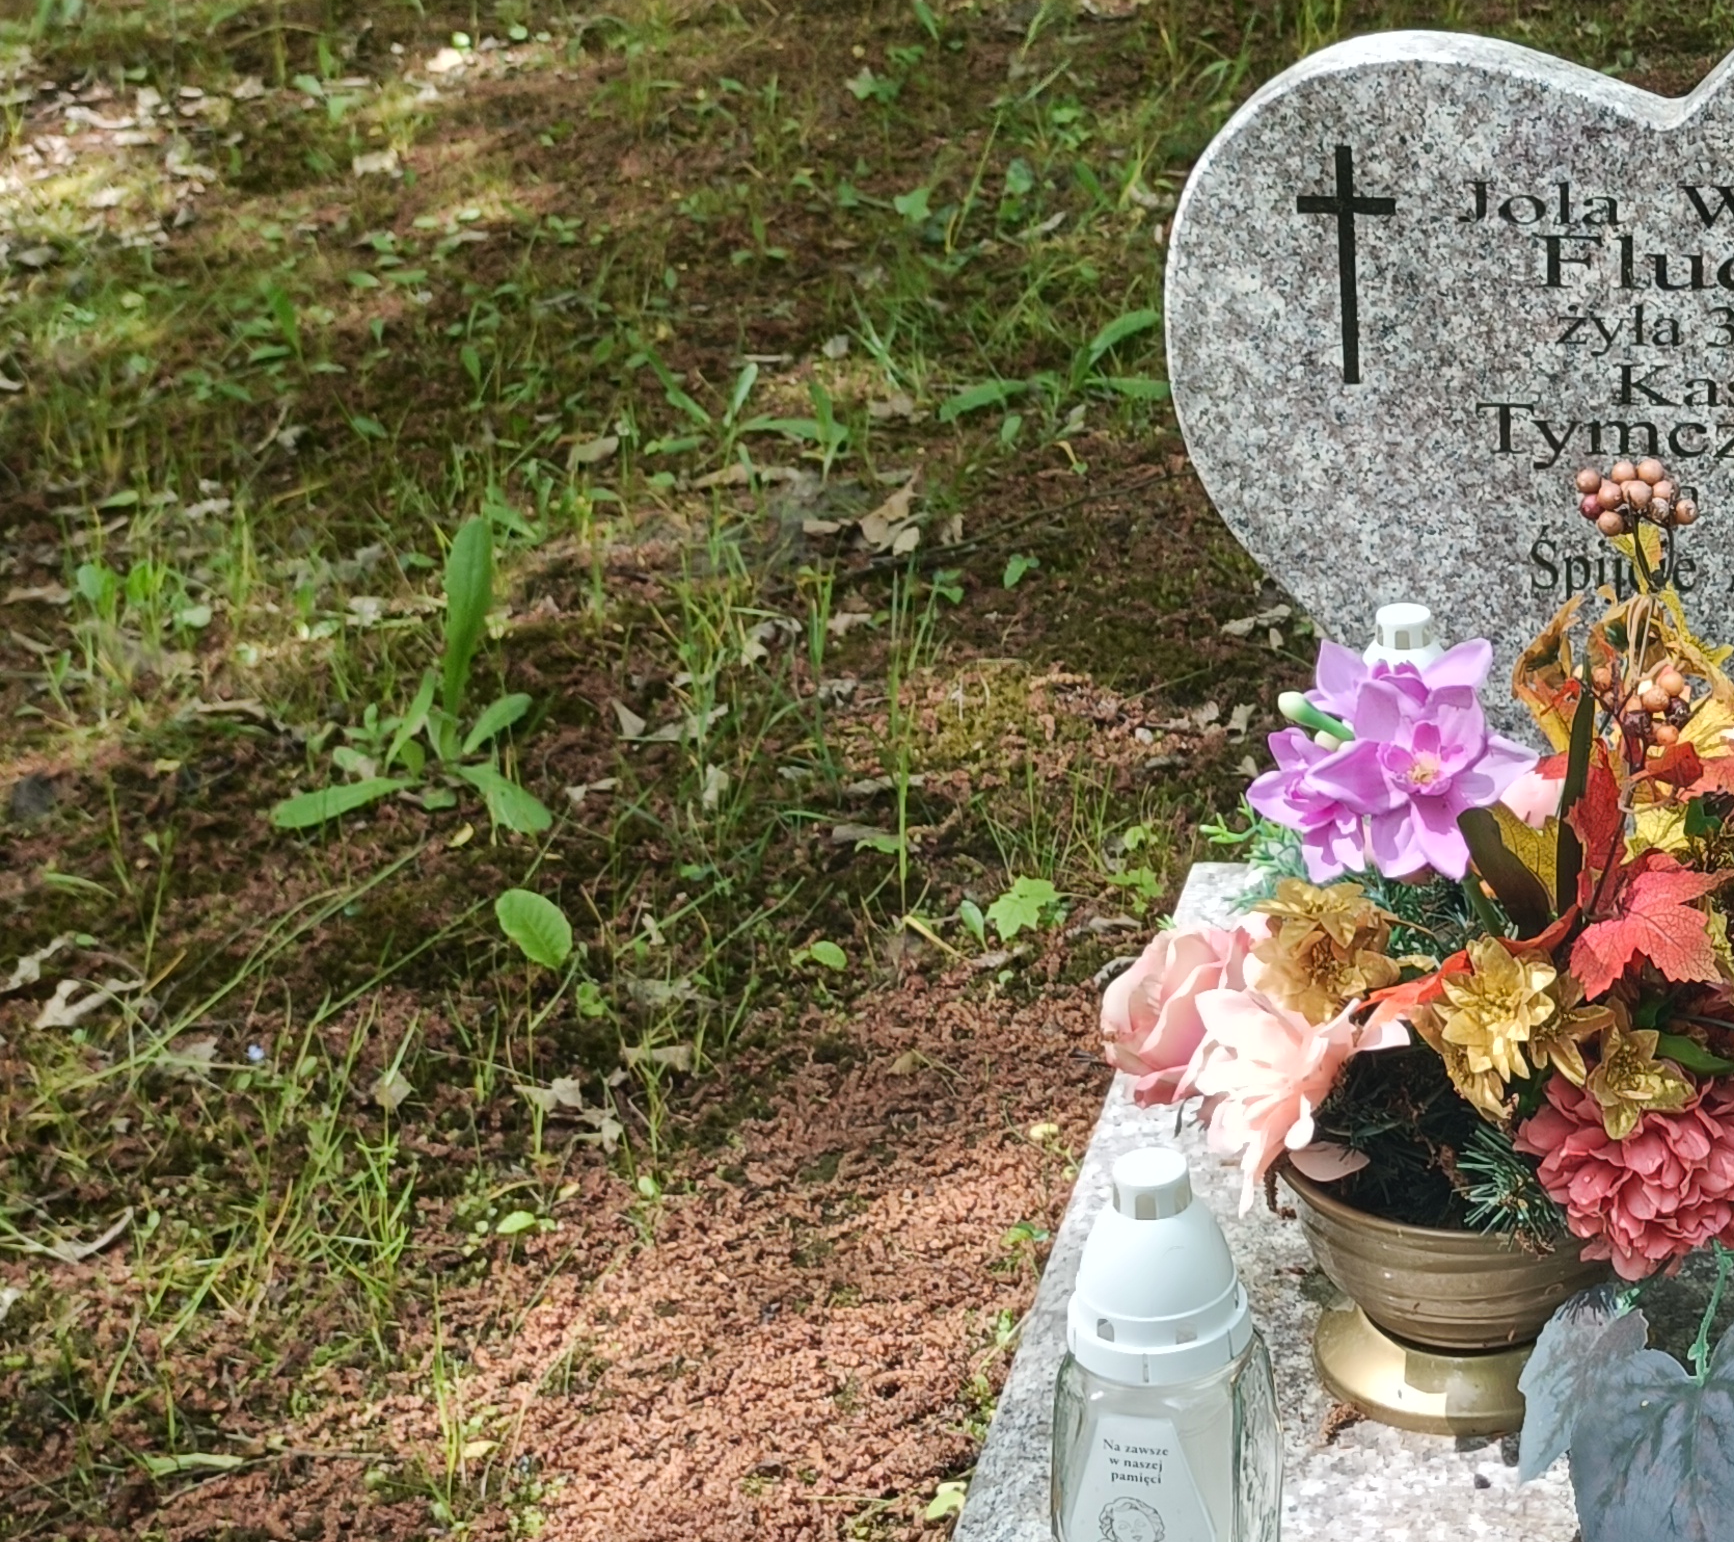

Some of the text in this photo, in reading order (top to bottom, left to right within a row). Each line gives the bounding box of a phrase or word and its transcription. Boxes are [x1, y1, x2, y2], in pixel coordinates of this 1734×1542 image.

[1458, 180, 1622, 226] Jola
[1555, 303, 1682, 357] żyła
[1103, 1439, 1169, 1457] Na zawsze
[1109, 1457, 1162, 1473] w naszej
[1111, 1471, 1161, 1487] pamięci
